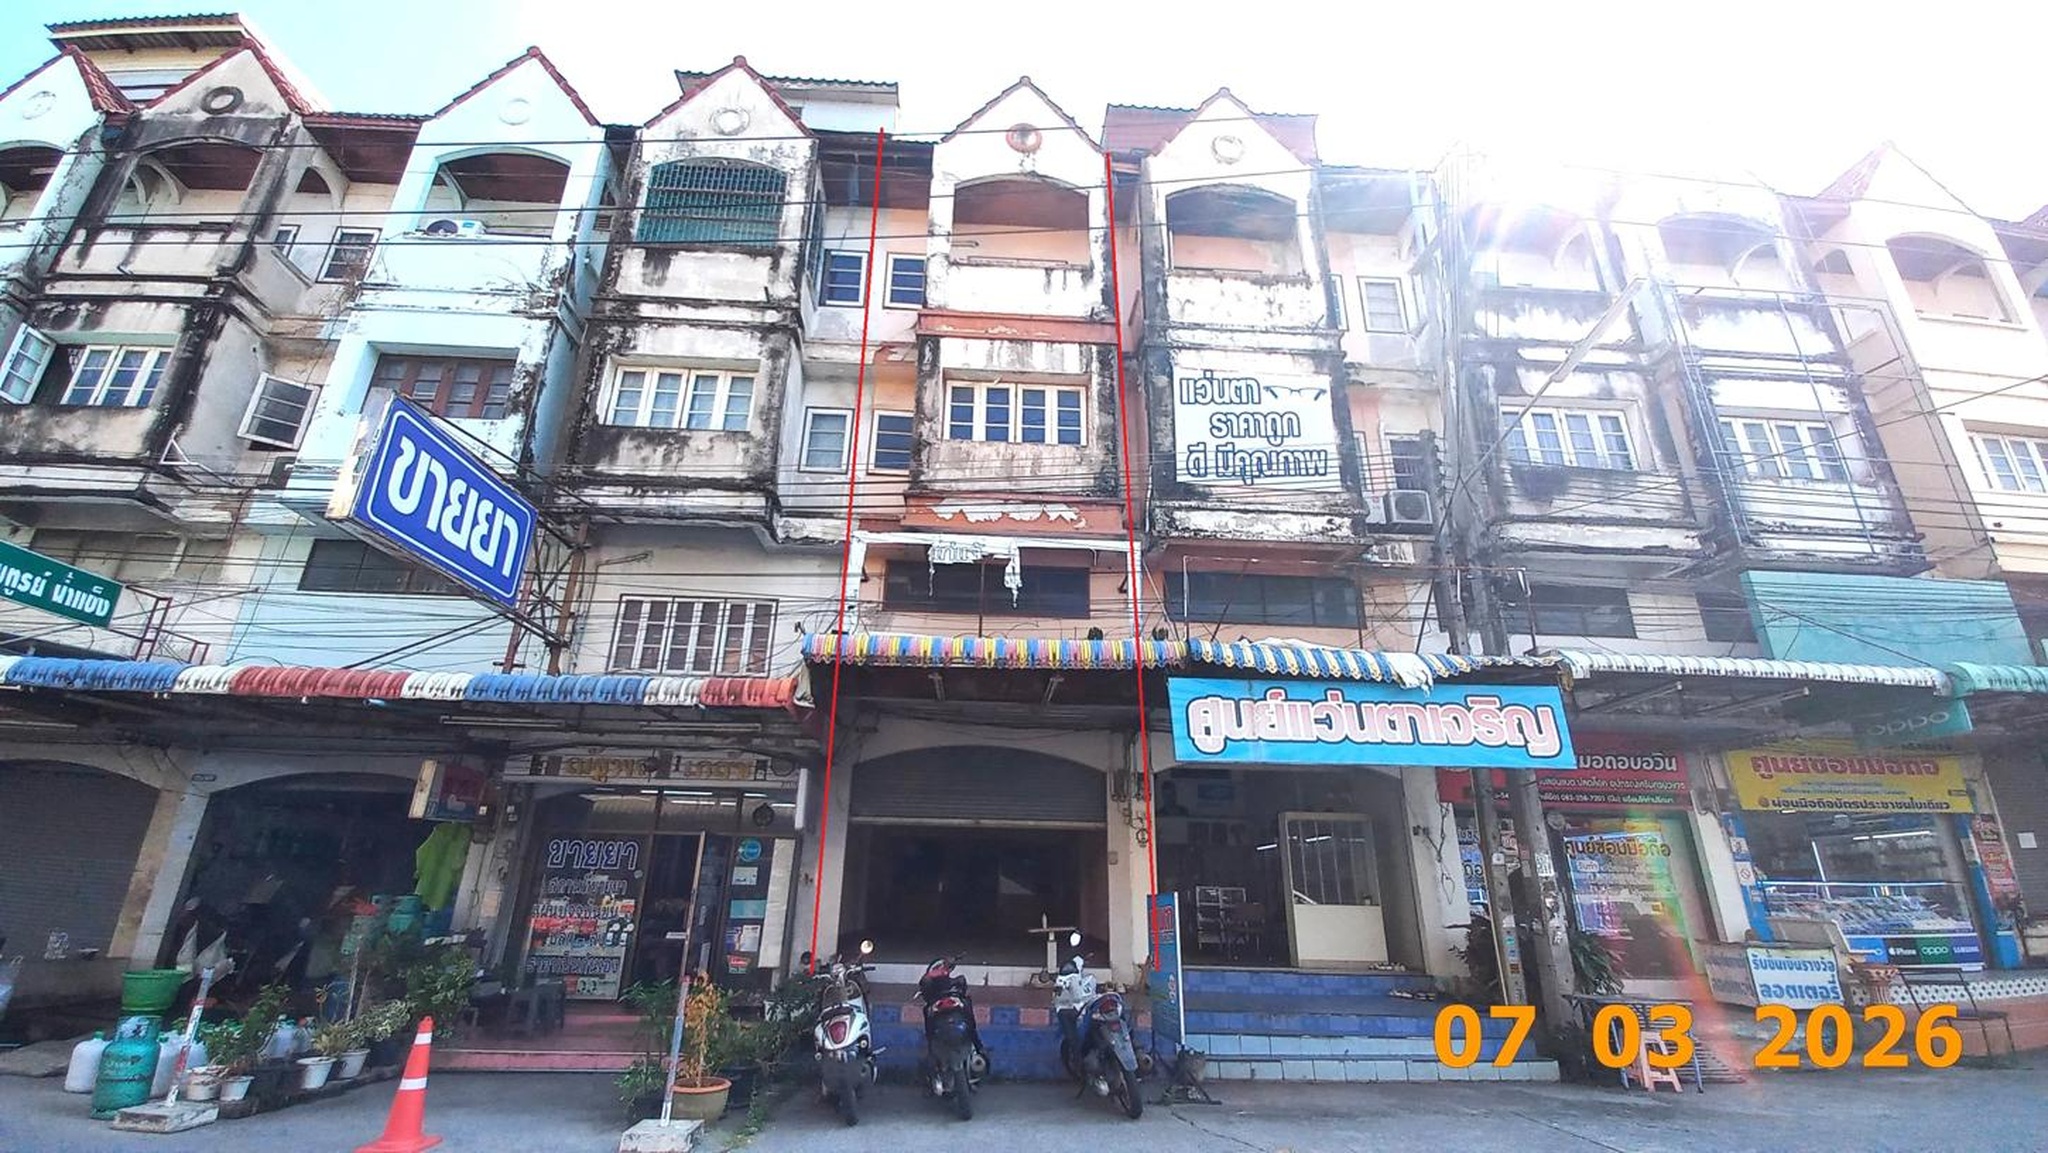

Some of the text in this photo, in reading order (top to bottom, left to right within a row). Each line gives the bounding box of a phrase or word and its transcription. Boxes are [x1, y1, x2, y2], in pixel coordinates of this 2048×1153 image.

[1180, 369, 1261, 404] แว่นตา
[1210, 411, 1301, 447] ราคาถูก
[1186, 442, 1328, 486] ดี มีคุณภาพ
[387, 435, 520, 579] ขายยา
[51, 571, 111, 618] น้ำแข็ง
[1187, 687, 1562, 758] ศูนย์แว่นตาเจริญ
[547, 839, 639, 870] ขายยา
